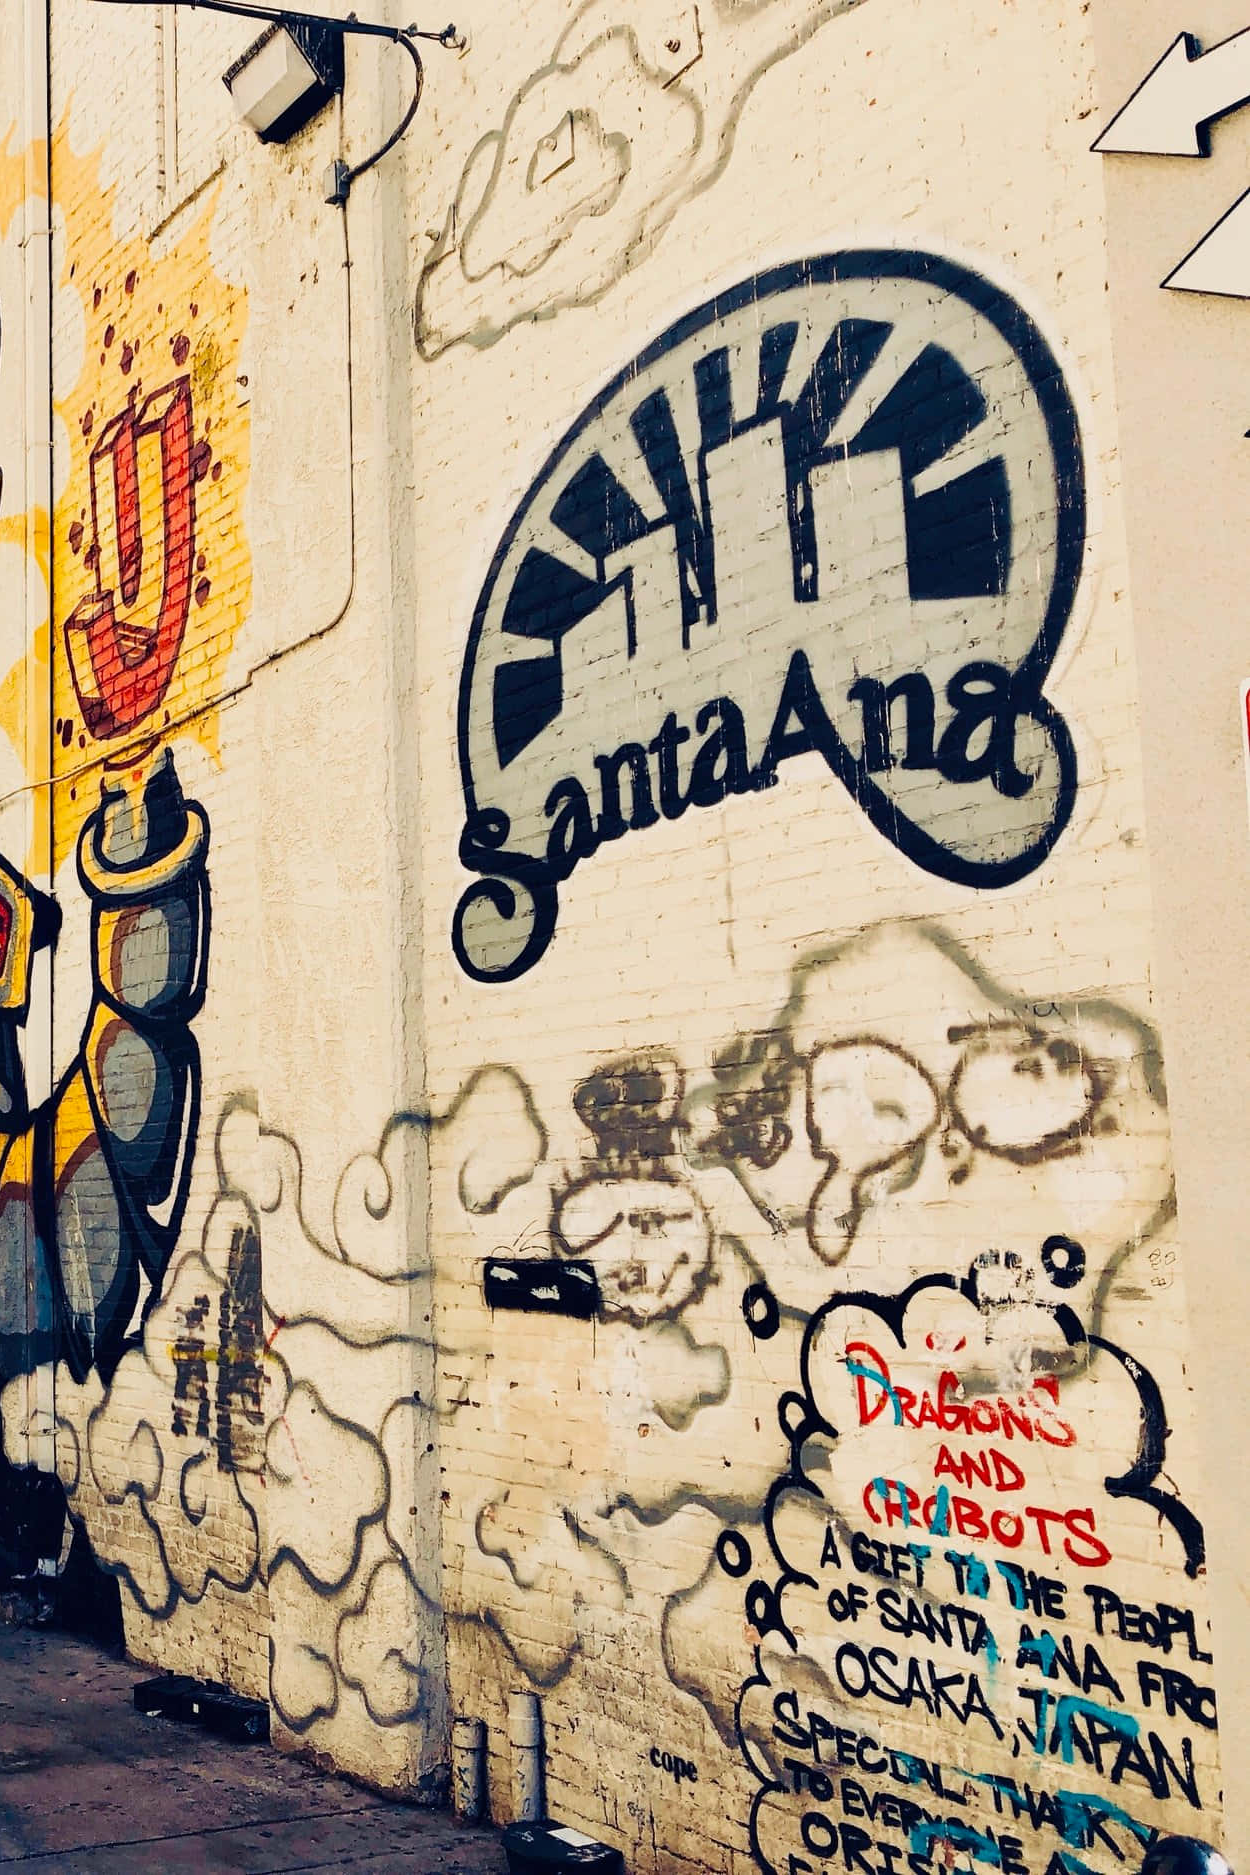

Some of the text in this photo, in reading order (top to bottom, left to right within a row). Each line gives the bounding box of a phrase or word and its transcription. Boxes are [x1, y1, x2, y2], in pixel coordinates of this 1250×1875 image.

[846, 1341, 1078, 1447] DRAGONS
[934, 1445, 1025, 1491] AND
[863, 1477, 1112, 1567] ROBOTS
[821, 1525, 841, 1569] A
[852, 1532, 931, 1587] GIFT
[944, 1550, 990, 1599] TO
[995, 1560, 1067, 1619] THE
[828, 1582, 869, 1622] OF
[876, 1588, 996, 1656] SANTA
[1016, 1624, 1125, 1702] ANA
[649, 1746, 698, 1784] cope
[783, 1757, 834, 1801] TO
[1017, 1687, 1202, 1809] JAPAN
